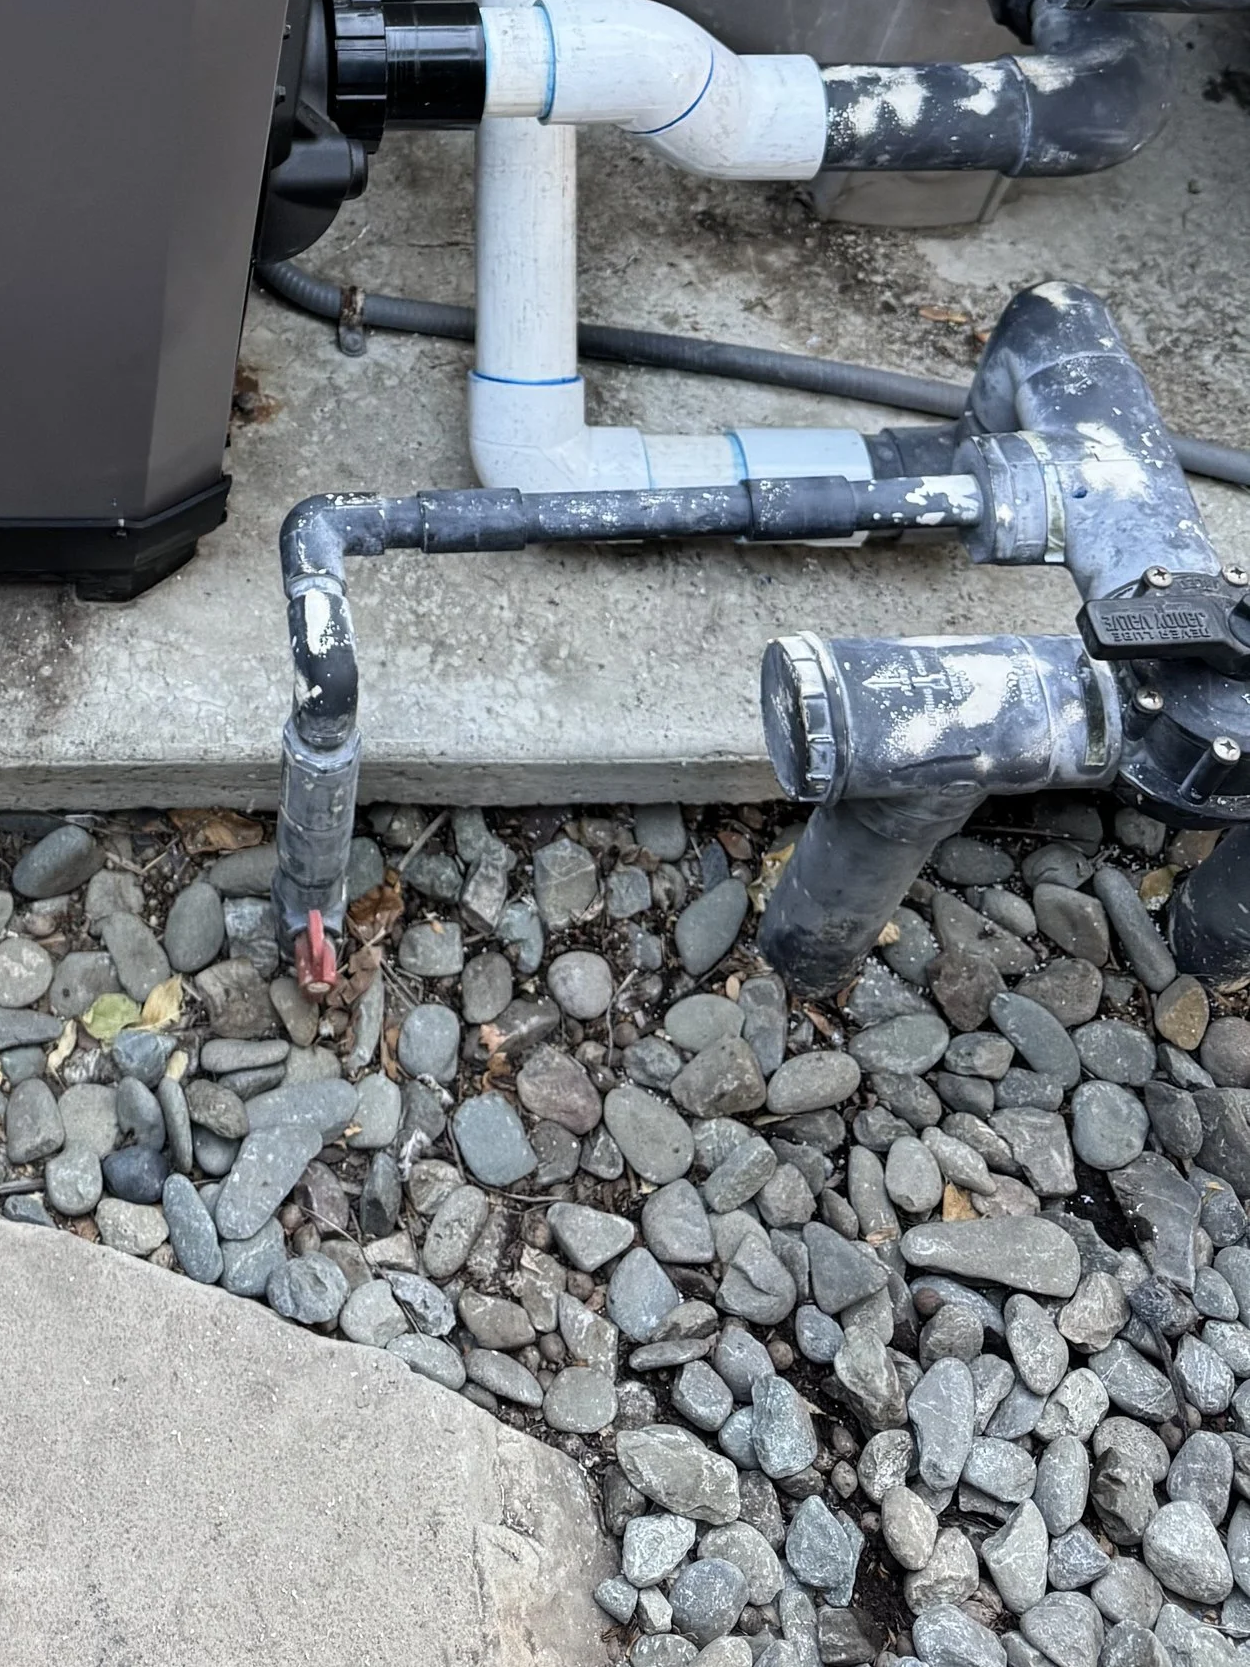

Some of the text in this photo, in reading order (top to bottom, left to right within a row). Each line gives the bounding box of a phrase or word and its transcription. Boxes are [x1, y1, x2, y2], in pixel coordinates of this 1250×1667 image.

[1100, 612, 1206, 632] JANDY VALVE
[1111, 629, 1212, 642] NEVER LUBE
